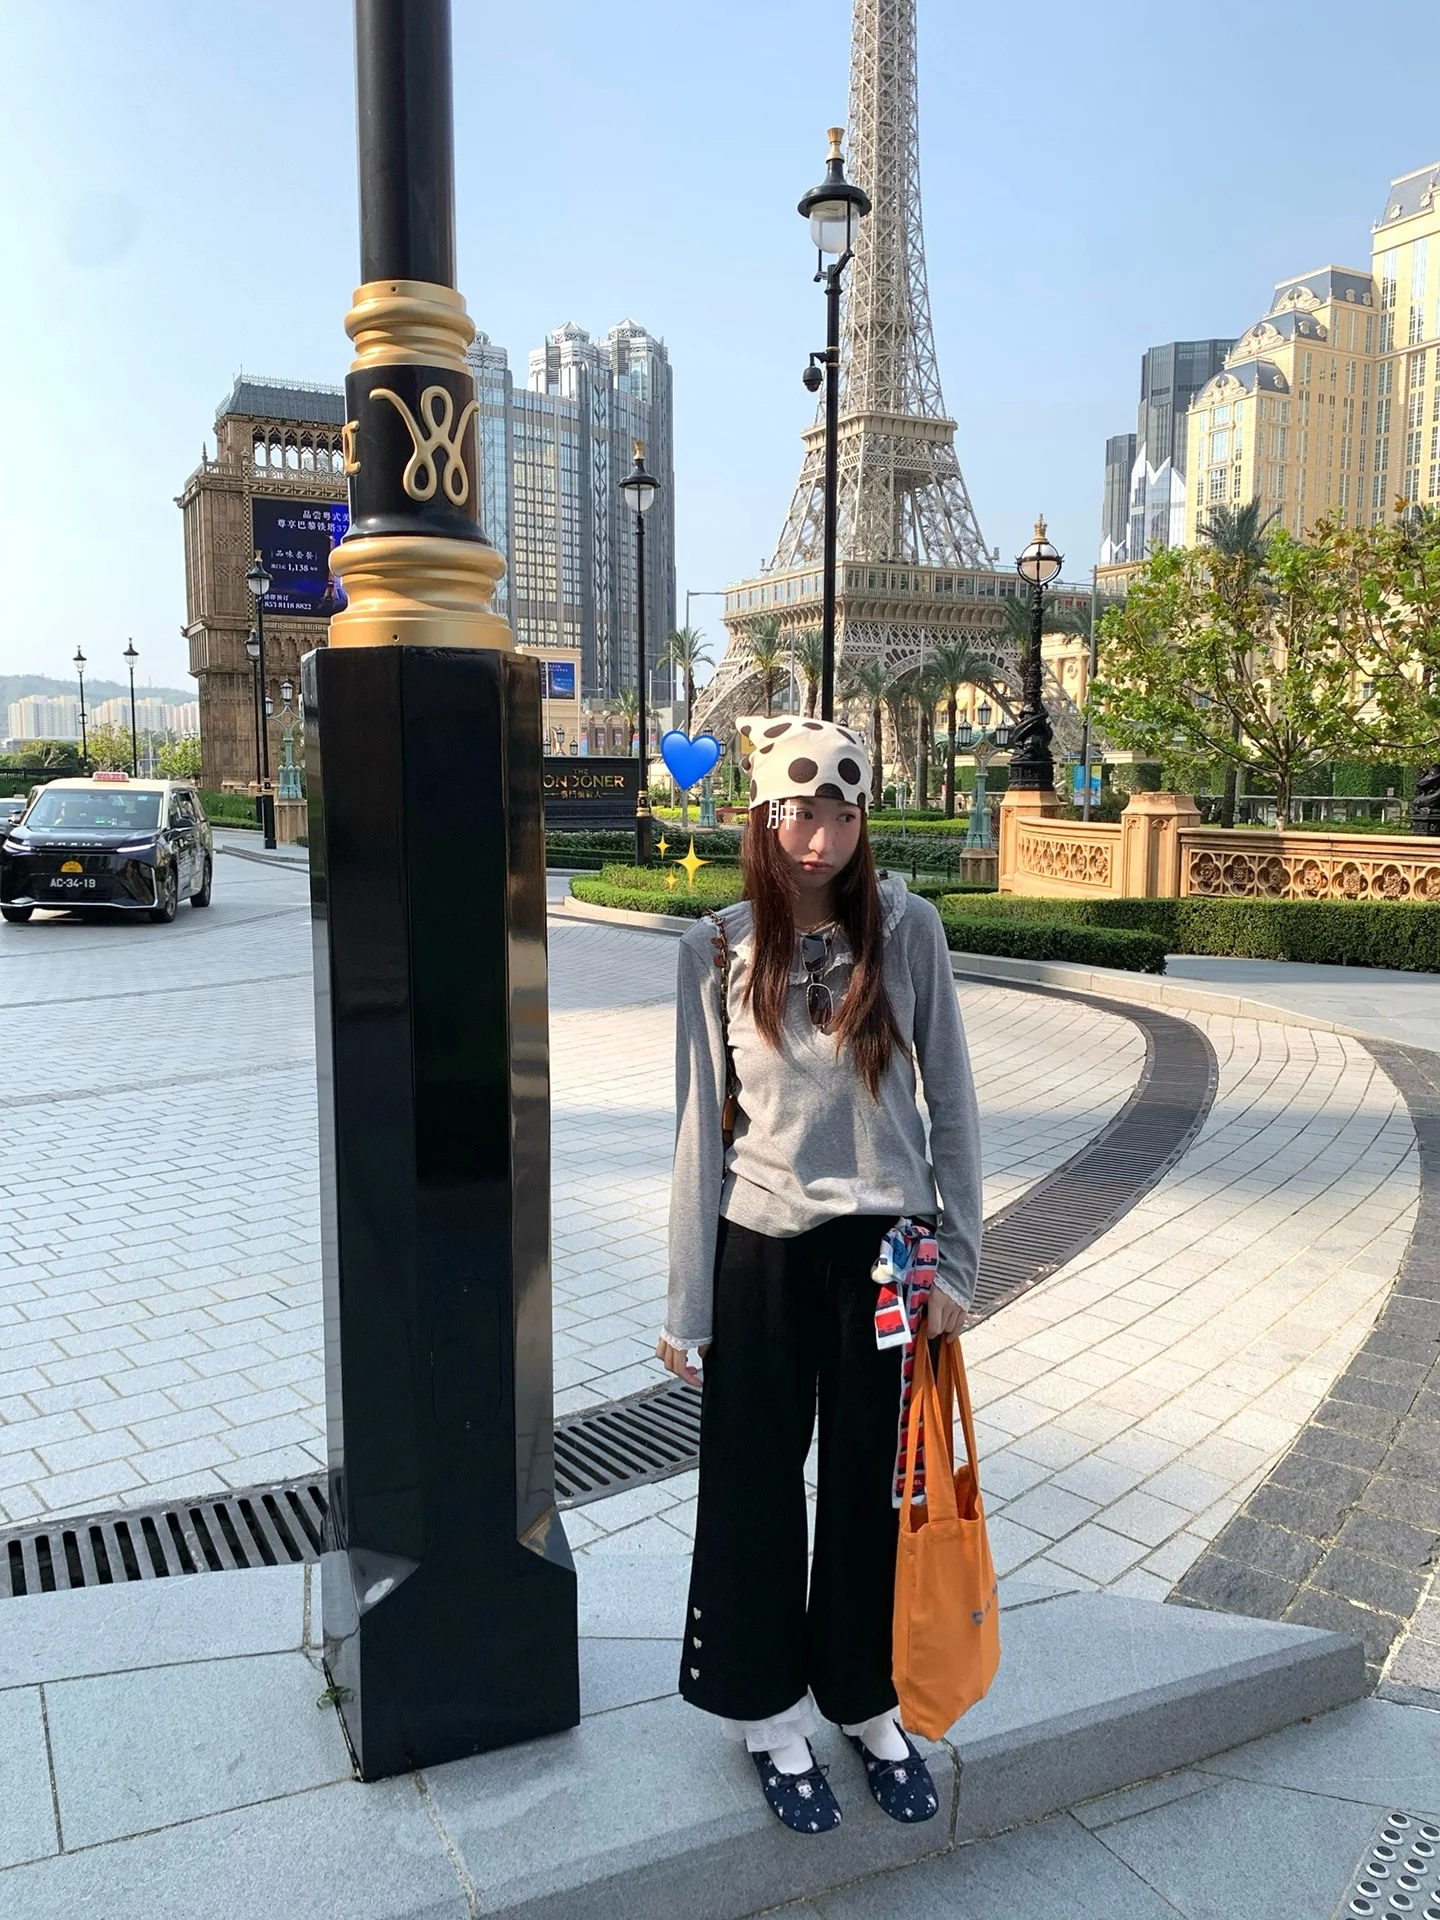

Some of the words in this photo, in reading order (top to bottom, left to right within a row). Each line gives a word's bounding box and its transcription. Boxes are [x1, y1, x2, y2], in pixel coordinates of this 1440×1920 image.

[288, 563, 309, 572] 1,138
[295, 602, 312, 610] 8822
[543, 774, 625, 788] ONDONER
